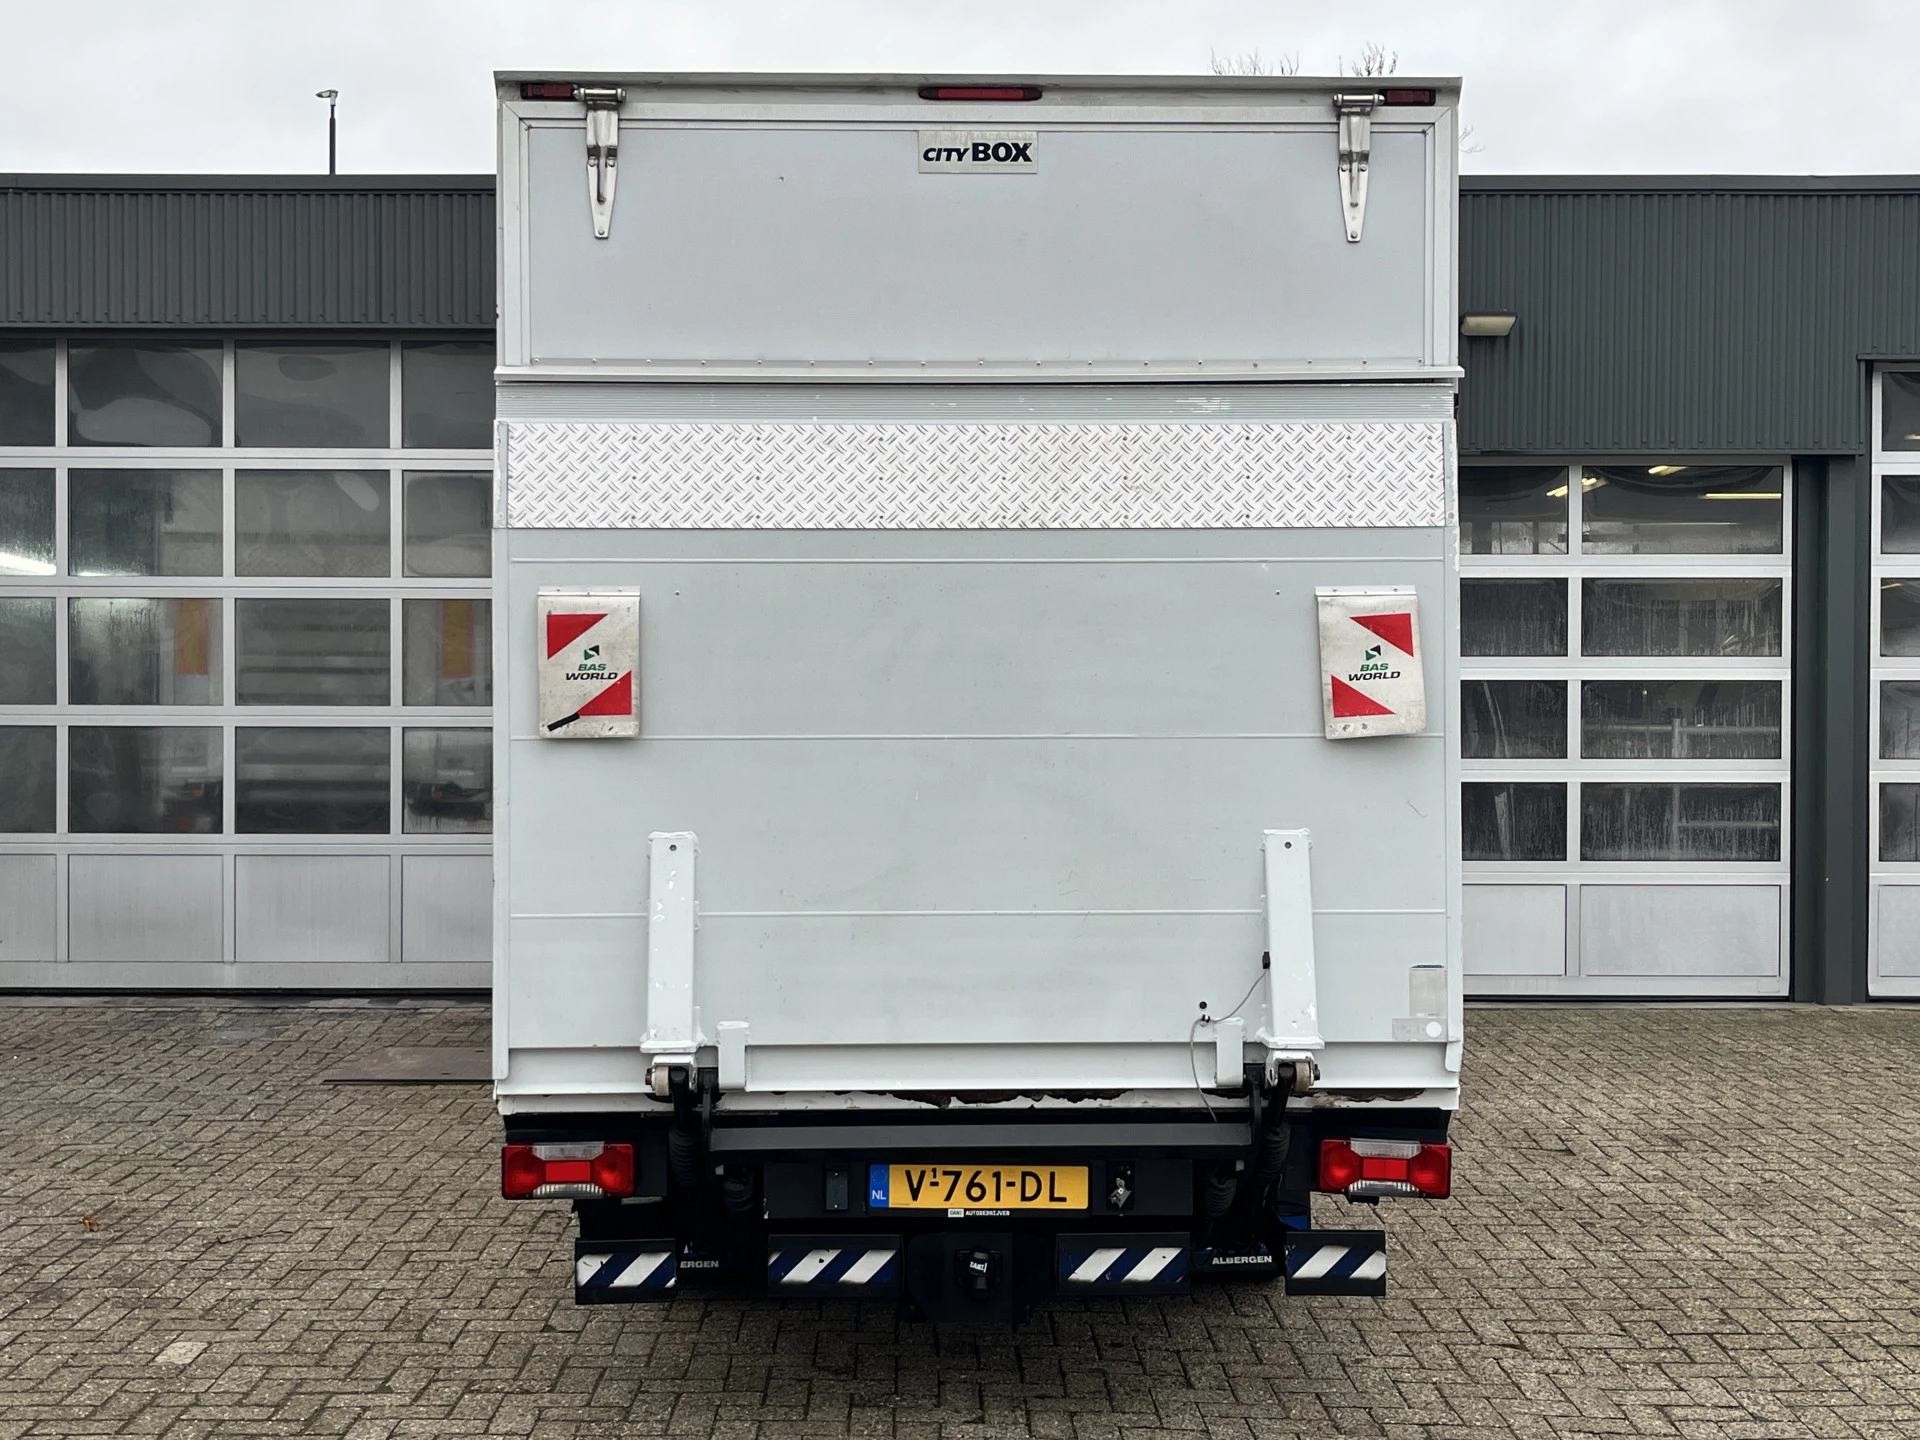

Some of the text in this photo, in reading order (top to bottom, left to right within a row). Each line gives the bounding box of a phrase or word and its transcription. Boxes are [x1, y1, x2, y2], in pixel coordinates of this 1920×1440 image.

[923, 142, 1033, 162] CITY BOX
[578, 663, 607, 671] BAS
[1360, 662, 1389, 672] BAS
[566, 672, 618, 681] WORLD
[1348, 671, 1401, 681] WORLD
[872, 1189, 887, 1200] NL
[1212, 1255, 1273, 1265] ALBERGEN
